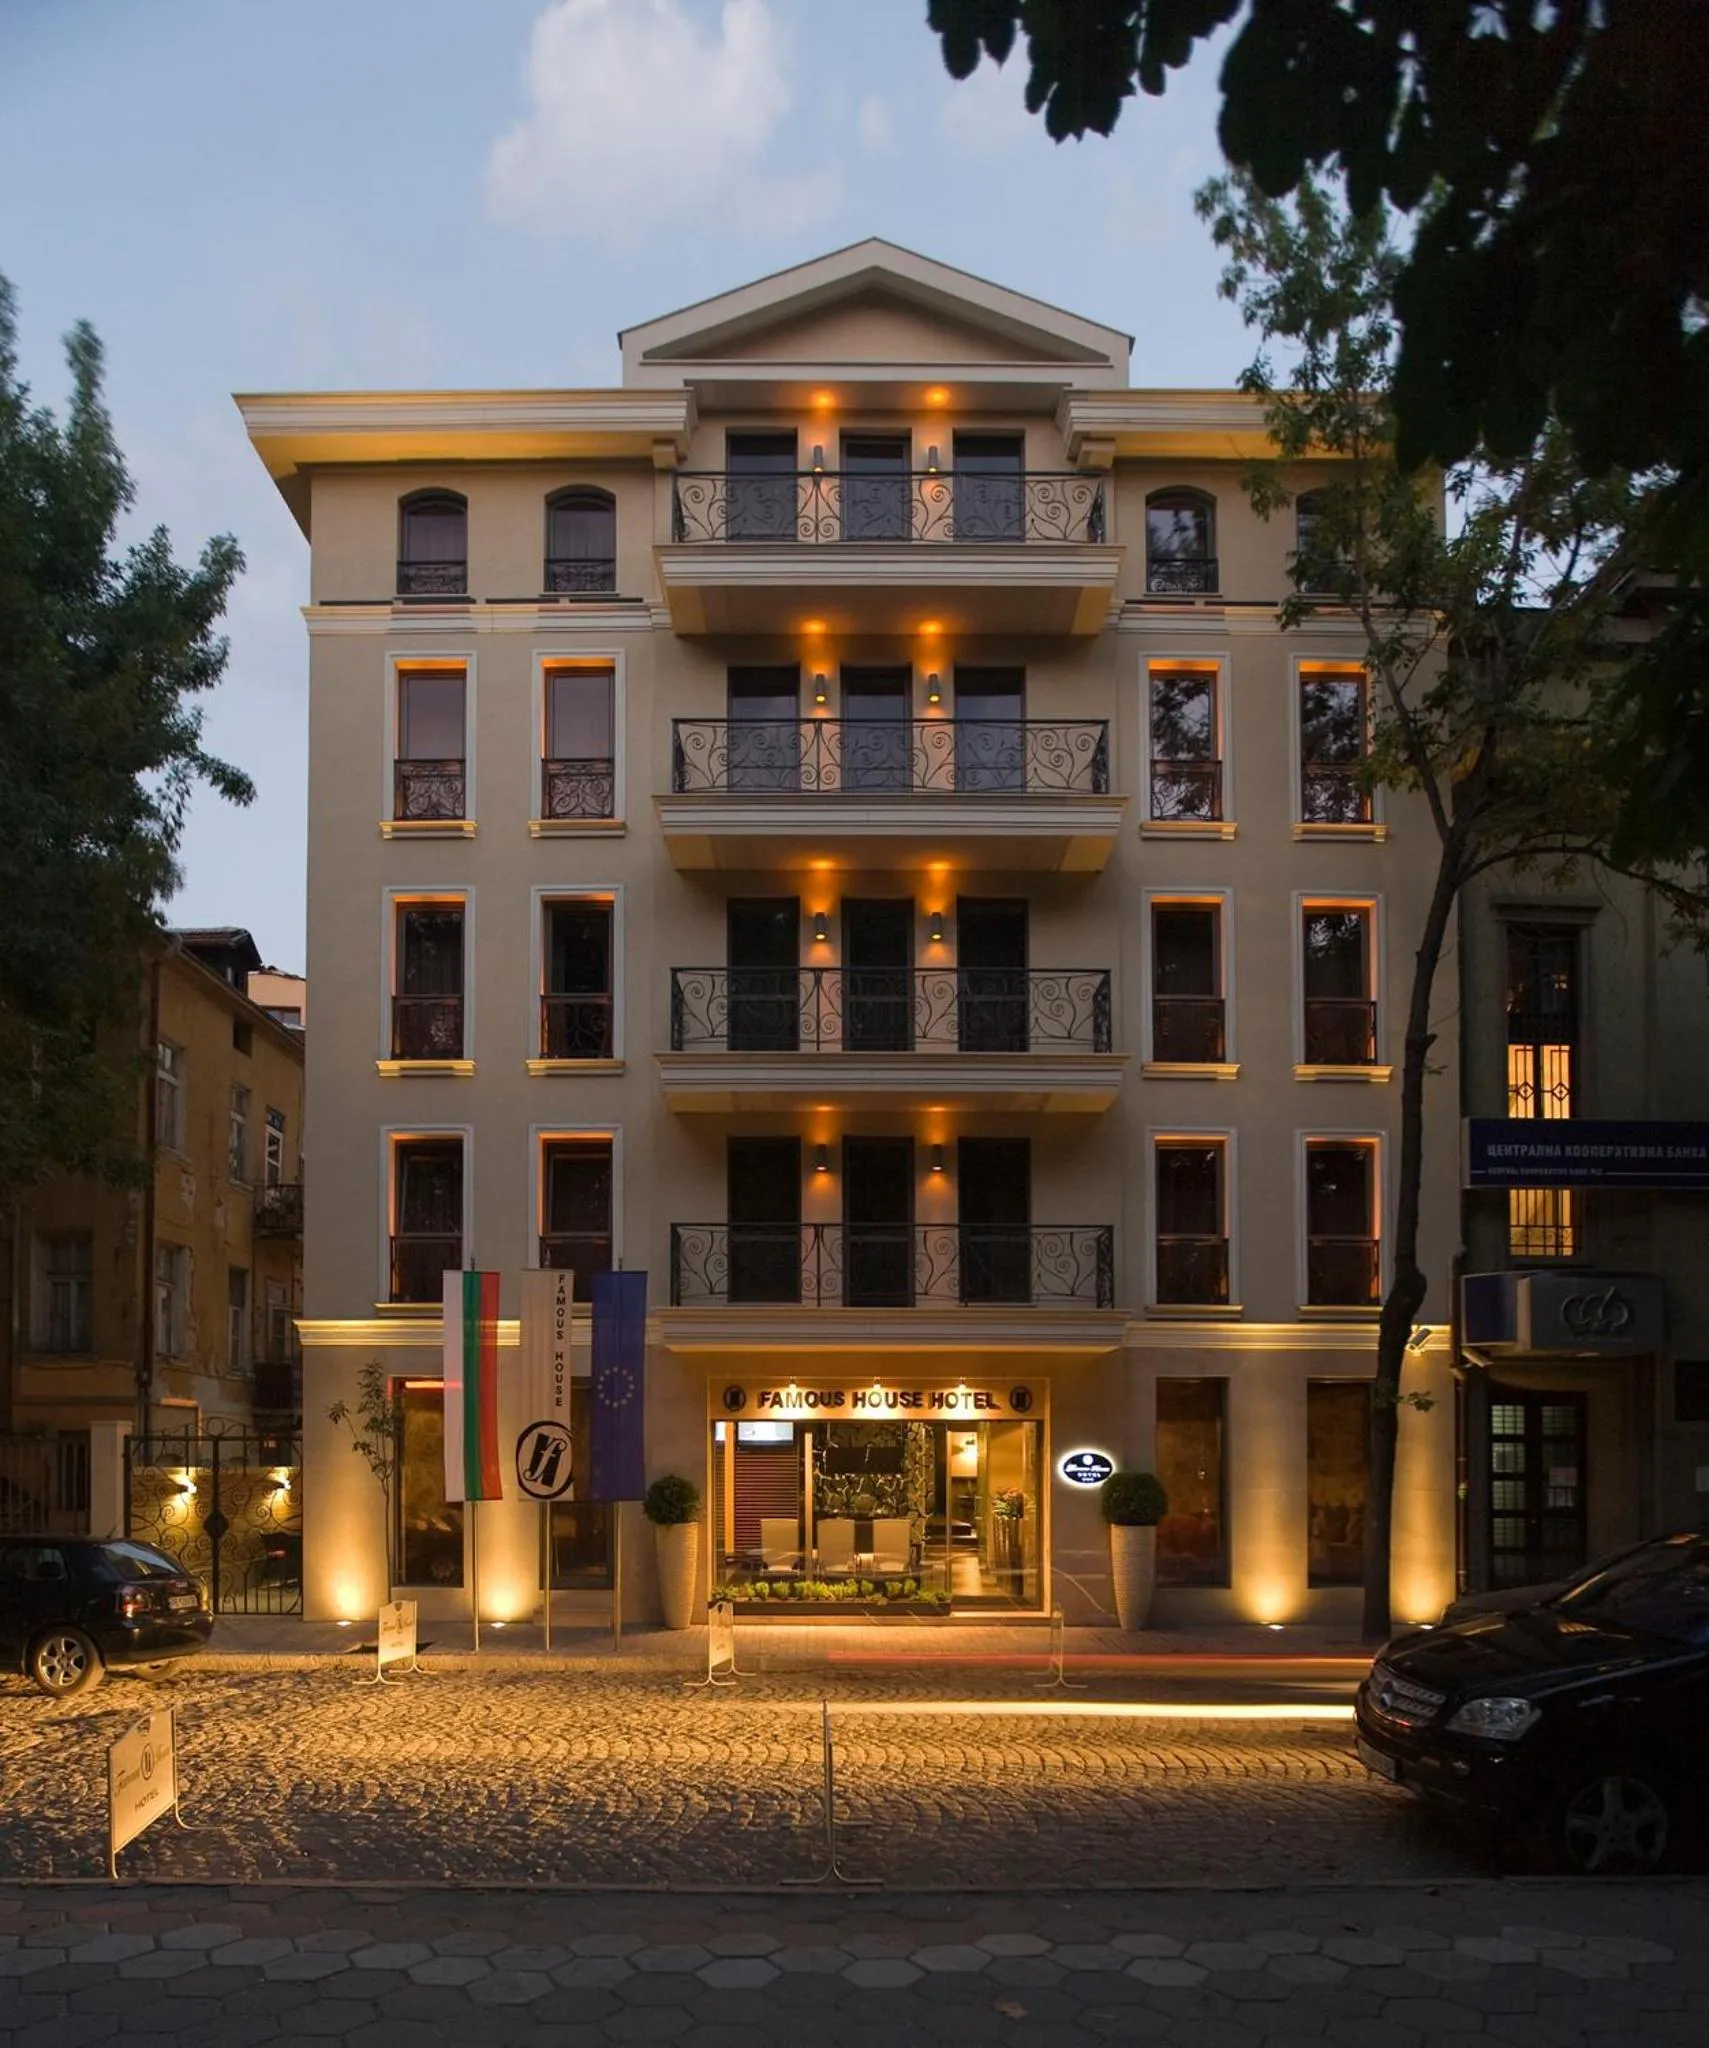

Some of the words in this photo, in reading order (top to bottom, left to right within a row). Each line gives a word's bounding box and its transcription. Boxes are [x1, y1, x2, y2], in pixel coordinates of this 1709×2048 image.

[1487, 1144, 1561, 1157] ЦЕНТРАЛНА
[555, 1274, 566, 1340] FAMOUS
[555, 1352, 564, 1407] HOUSE
[757, 1391, 846, 1409] FAMOUS
[851, 1391, 924, 1409] HOUSE
[928, 1391, 1001, 1410] HOTEL
